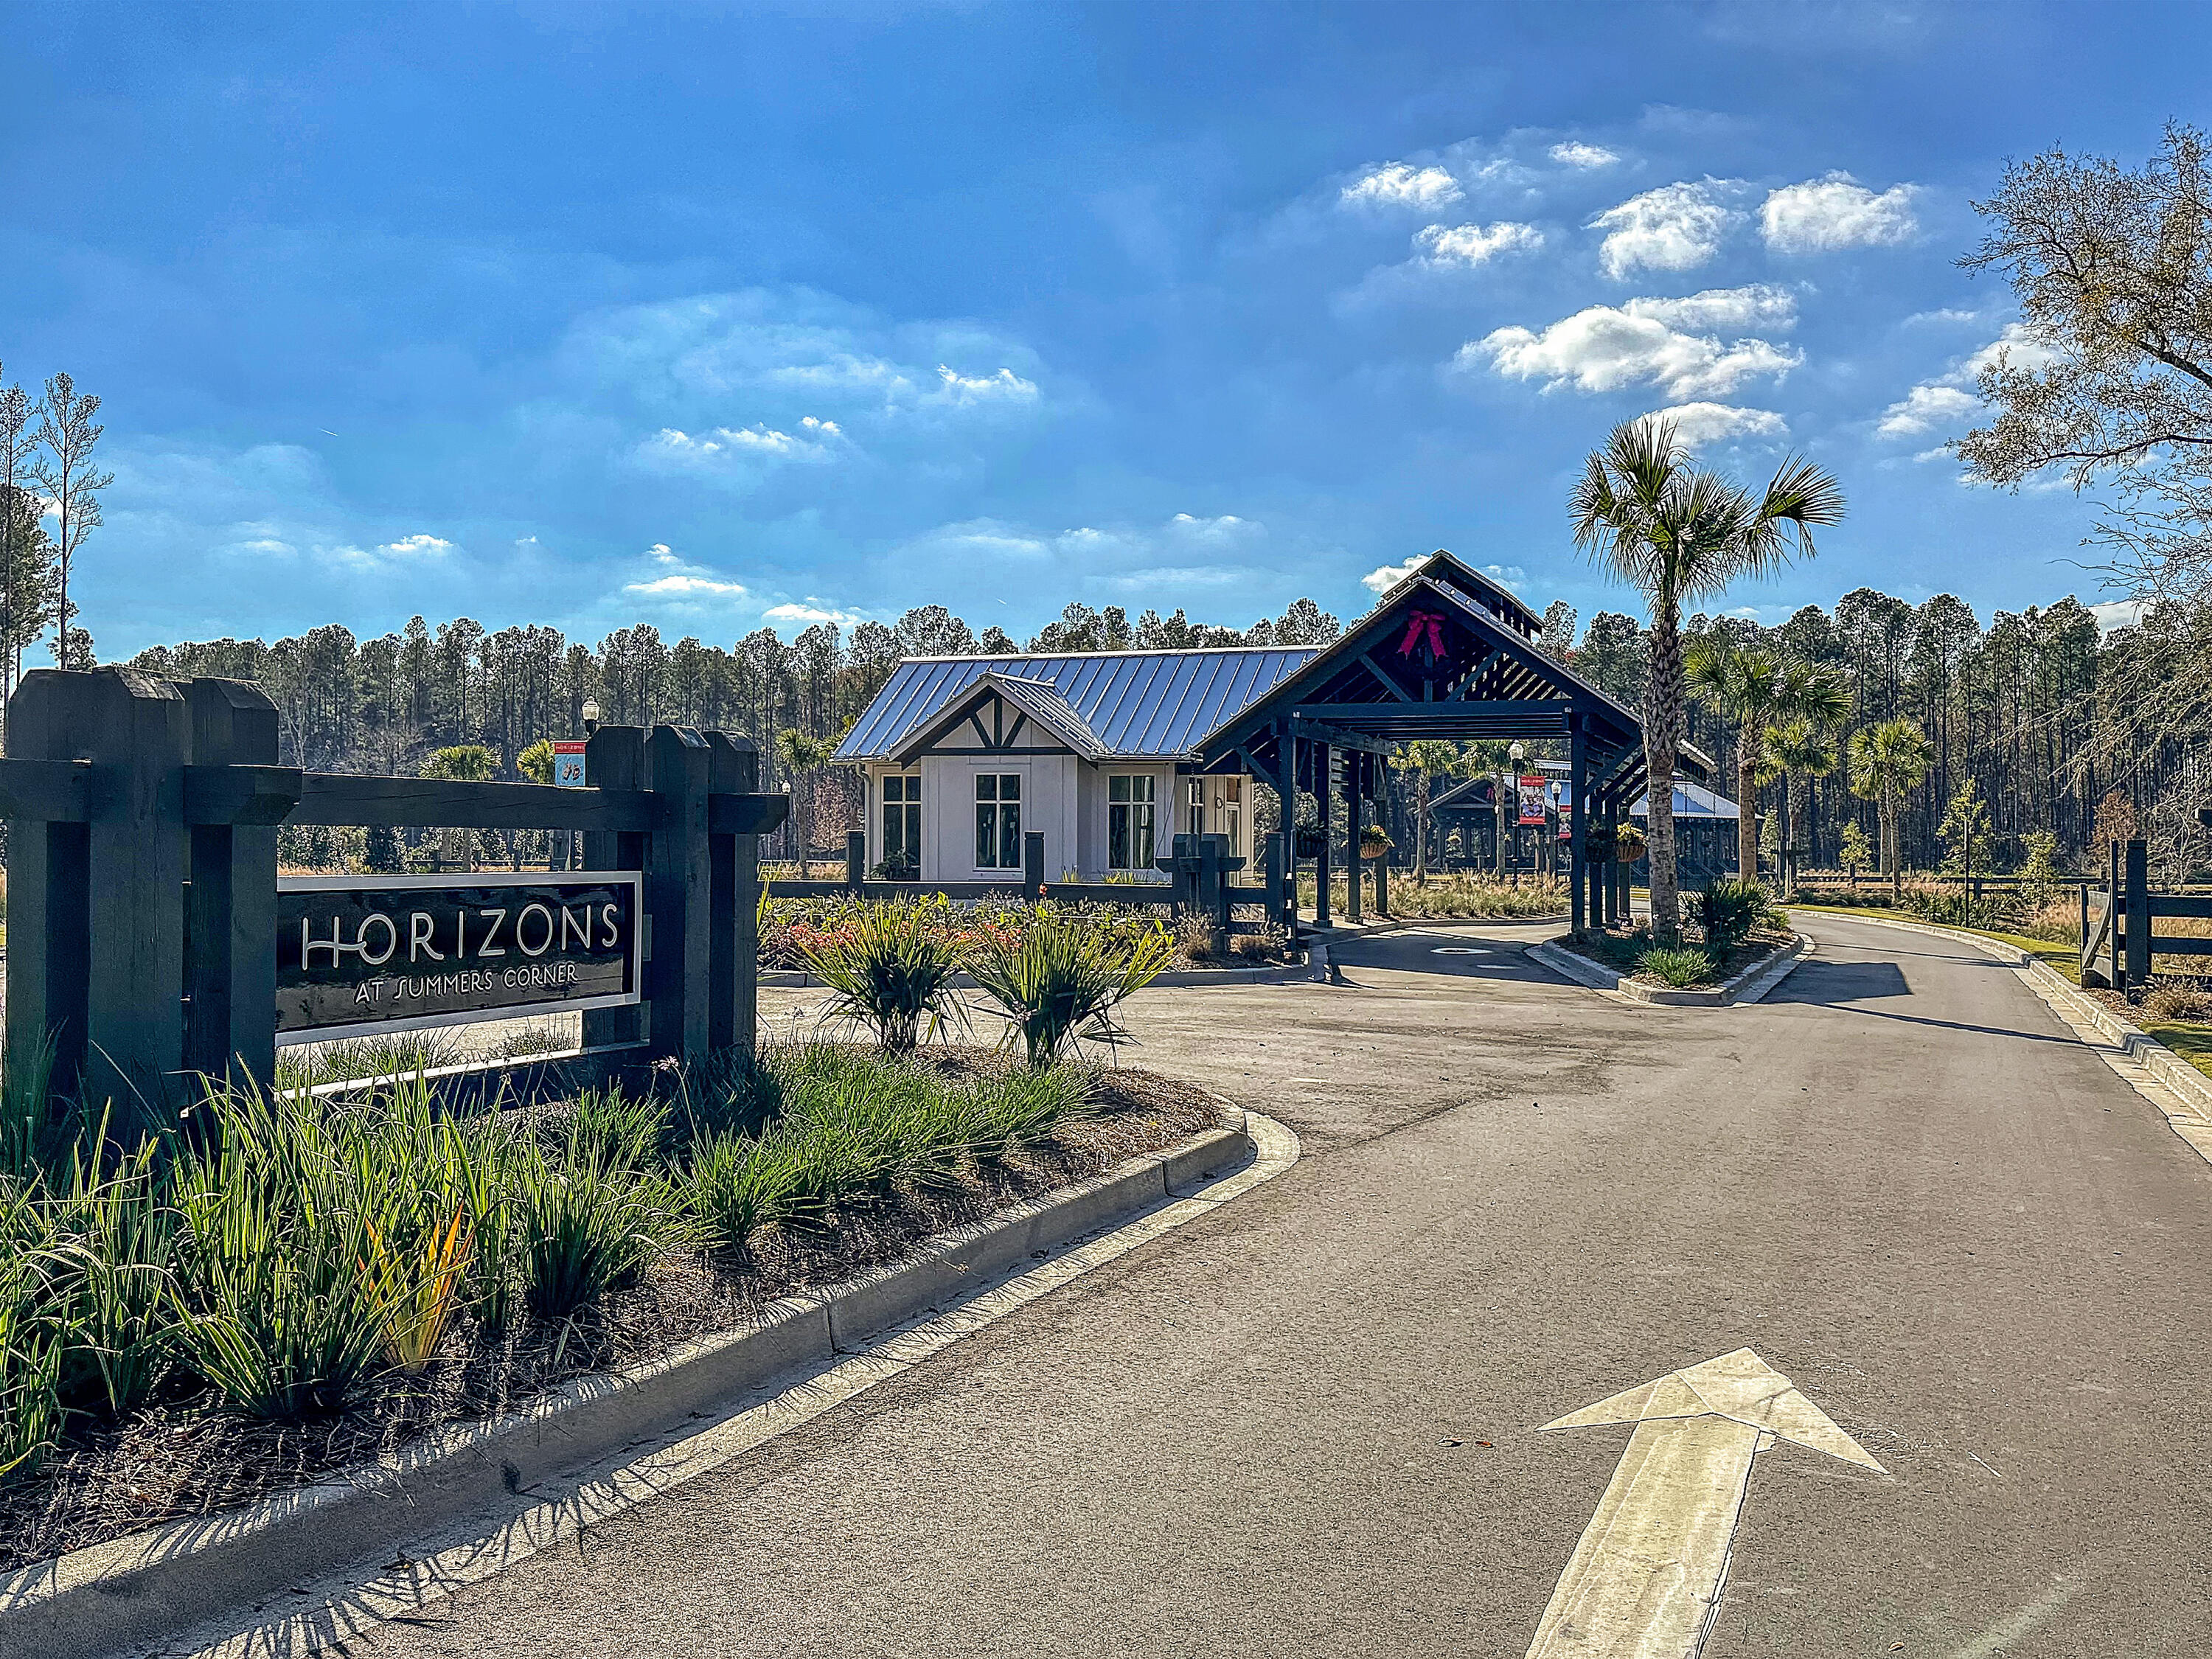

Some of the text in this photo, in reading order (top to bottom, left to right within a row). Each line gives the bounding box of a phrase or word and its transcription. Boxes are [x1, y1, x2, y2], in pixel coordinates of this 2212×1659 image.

[302, 903, 618, 971] HORIZONS
[355, 964, 579, 1003] AT SUMMERS CORNER
